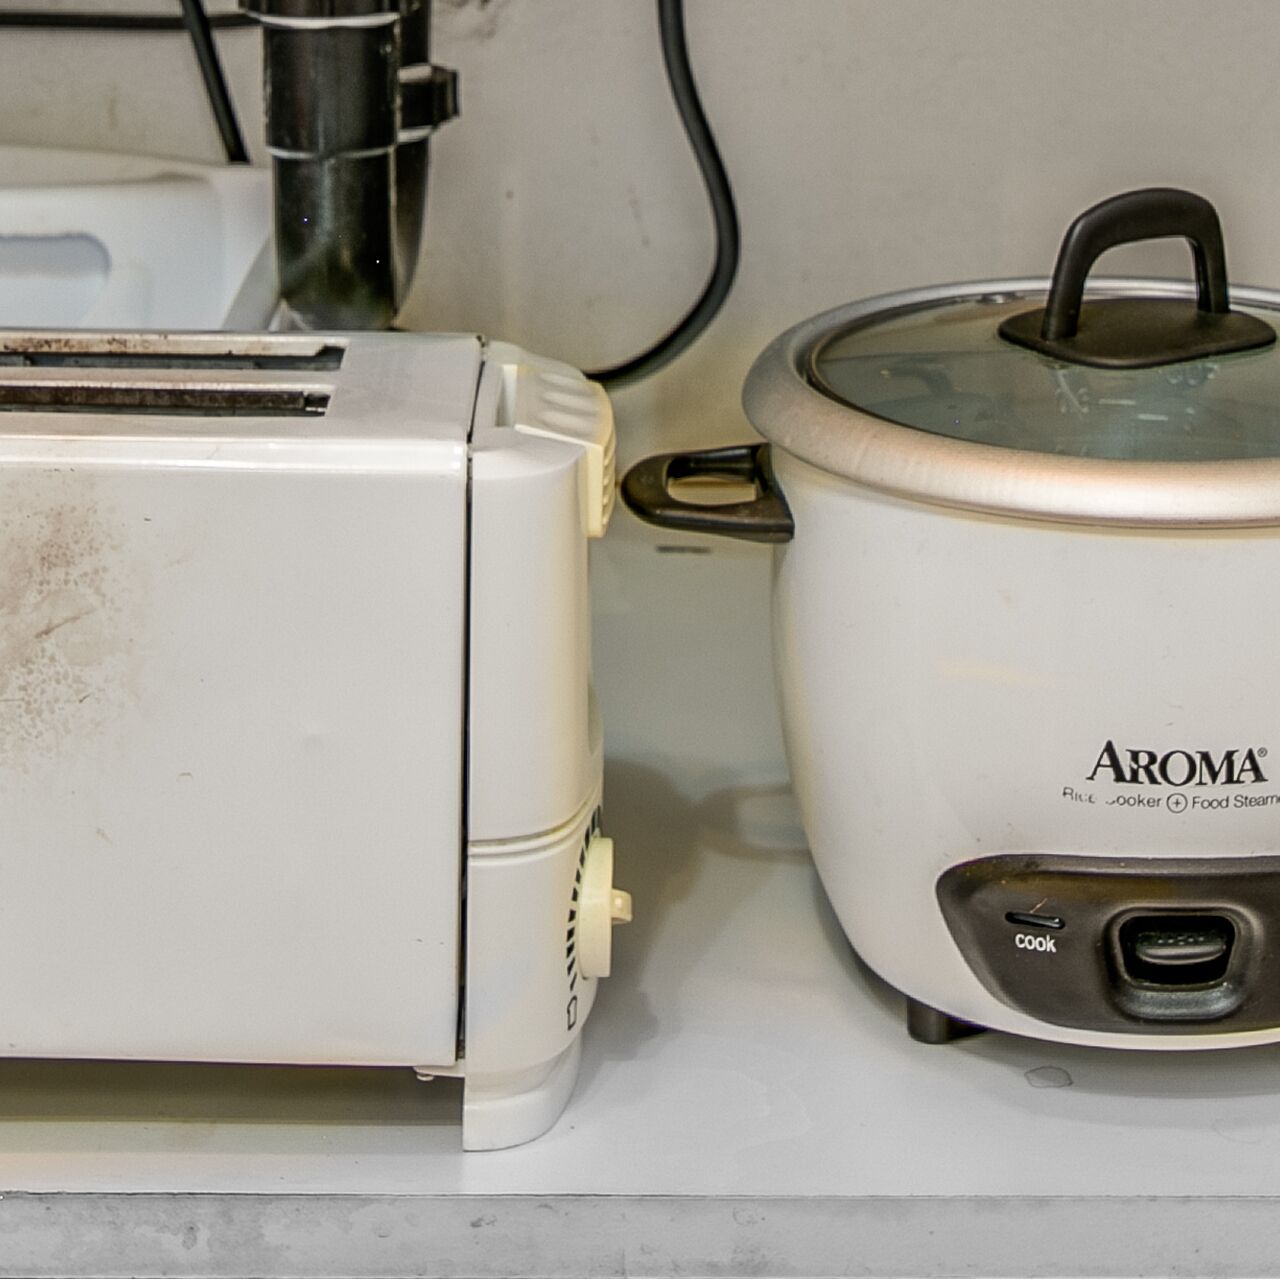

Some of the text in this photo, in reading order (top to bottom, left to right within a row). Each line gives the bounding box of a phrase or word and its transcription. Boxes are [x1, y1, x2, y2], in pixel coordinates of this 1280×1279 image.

[1086, 739, 1269, 786] AROMA
[1191, 795, 1230, 810] Food
[1014, 932, 1057, 954] cook
